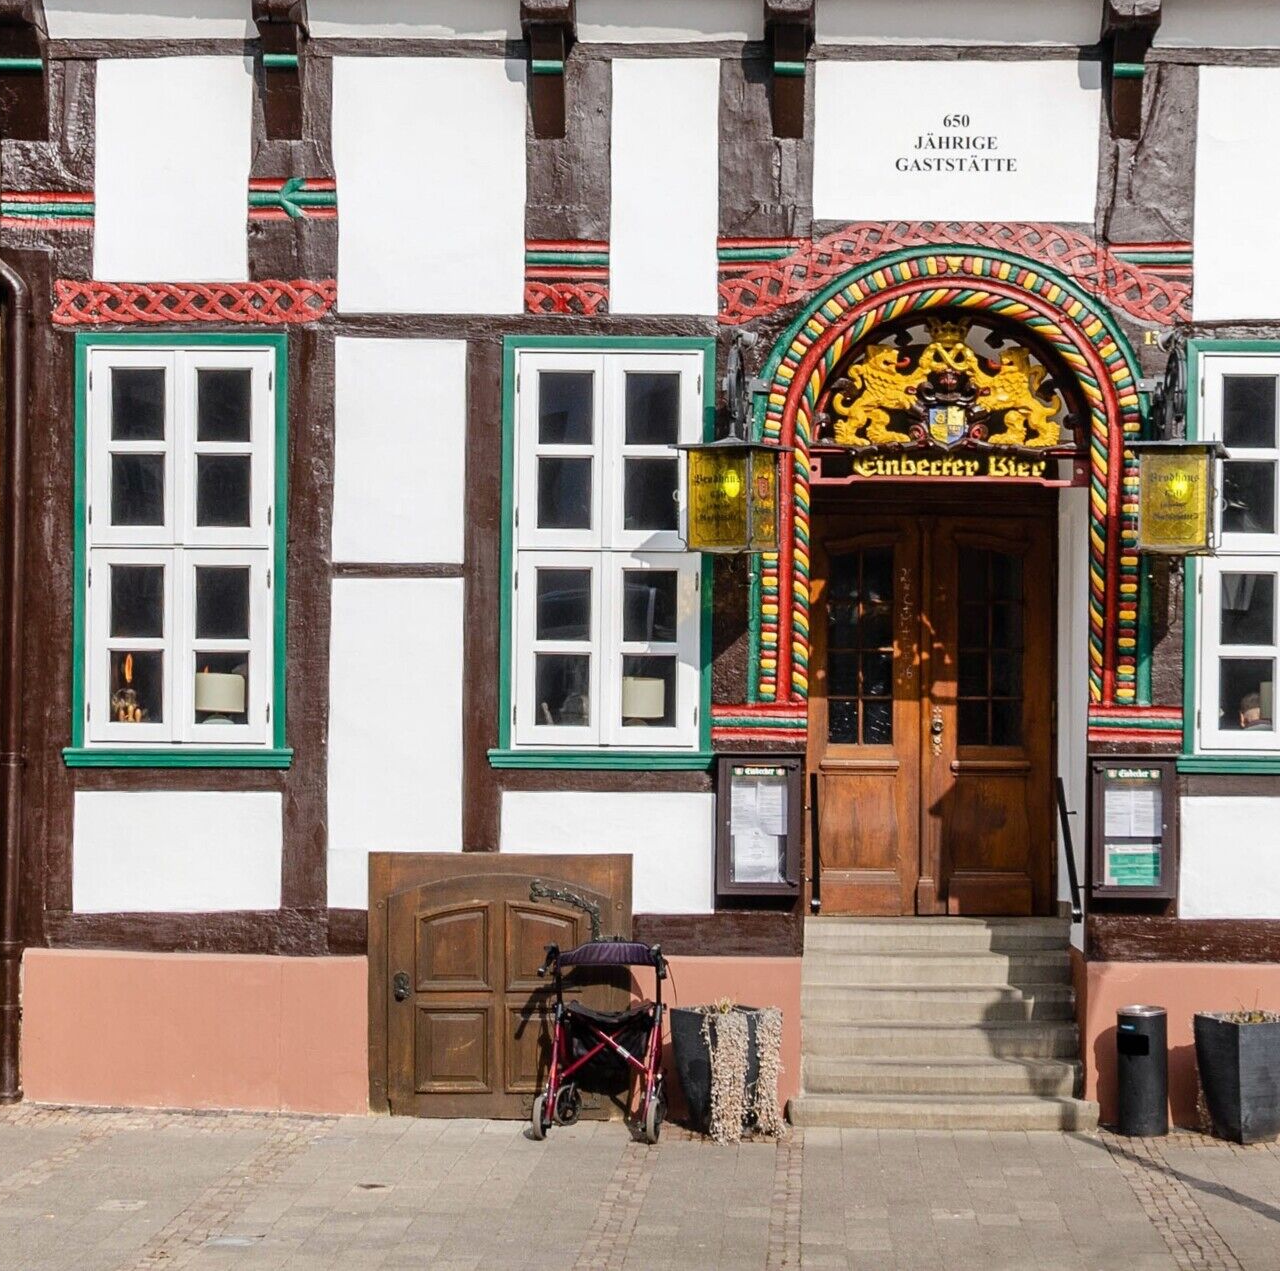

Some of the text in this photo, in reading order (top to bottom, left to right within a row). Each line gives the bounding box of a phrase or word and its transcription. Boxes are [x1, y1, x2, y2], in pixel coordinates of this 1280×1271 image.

[943, 114, 970, 128] 650
[914, 133, 998, 150] JÄHRIGE
[895, 155, 1017, 172] GASTSTÄTTE
[988, 455, 1047, 477] Bier
